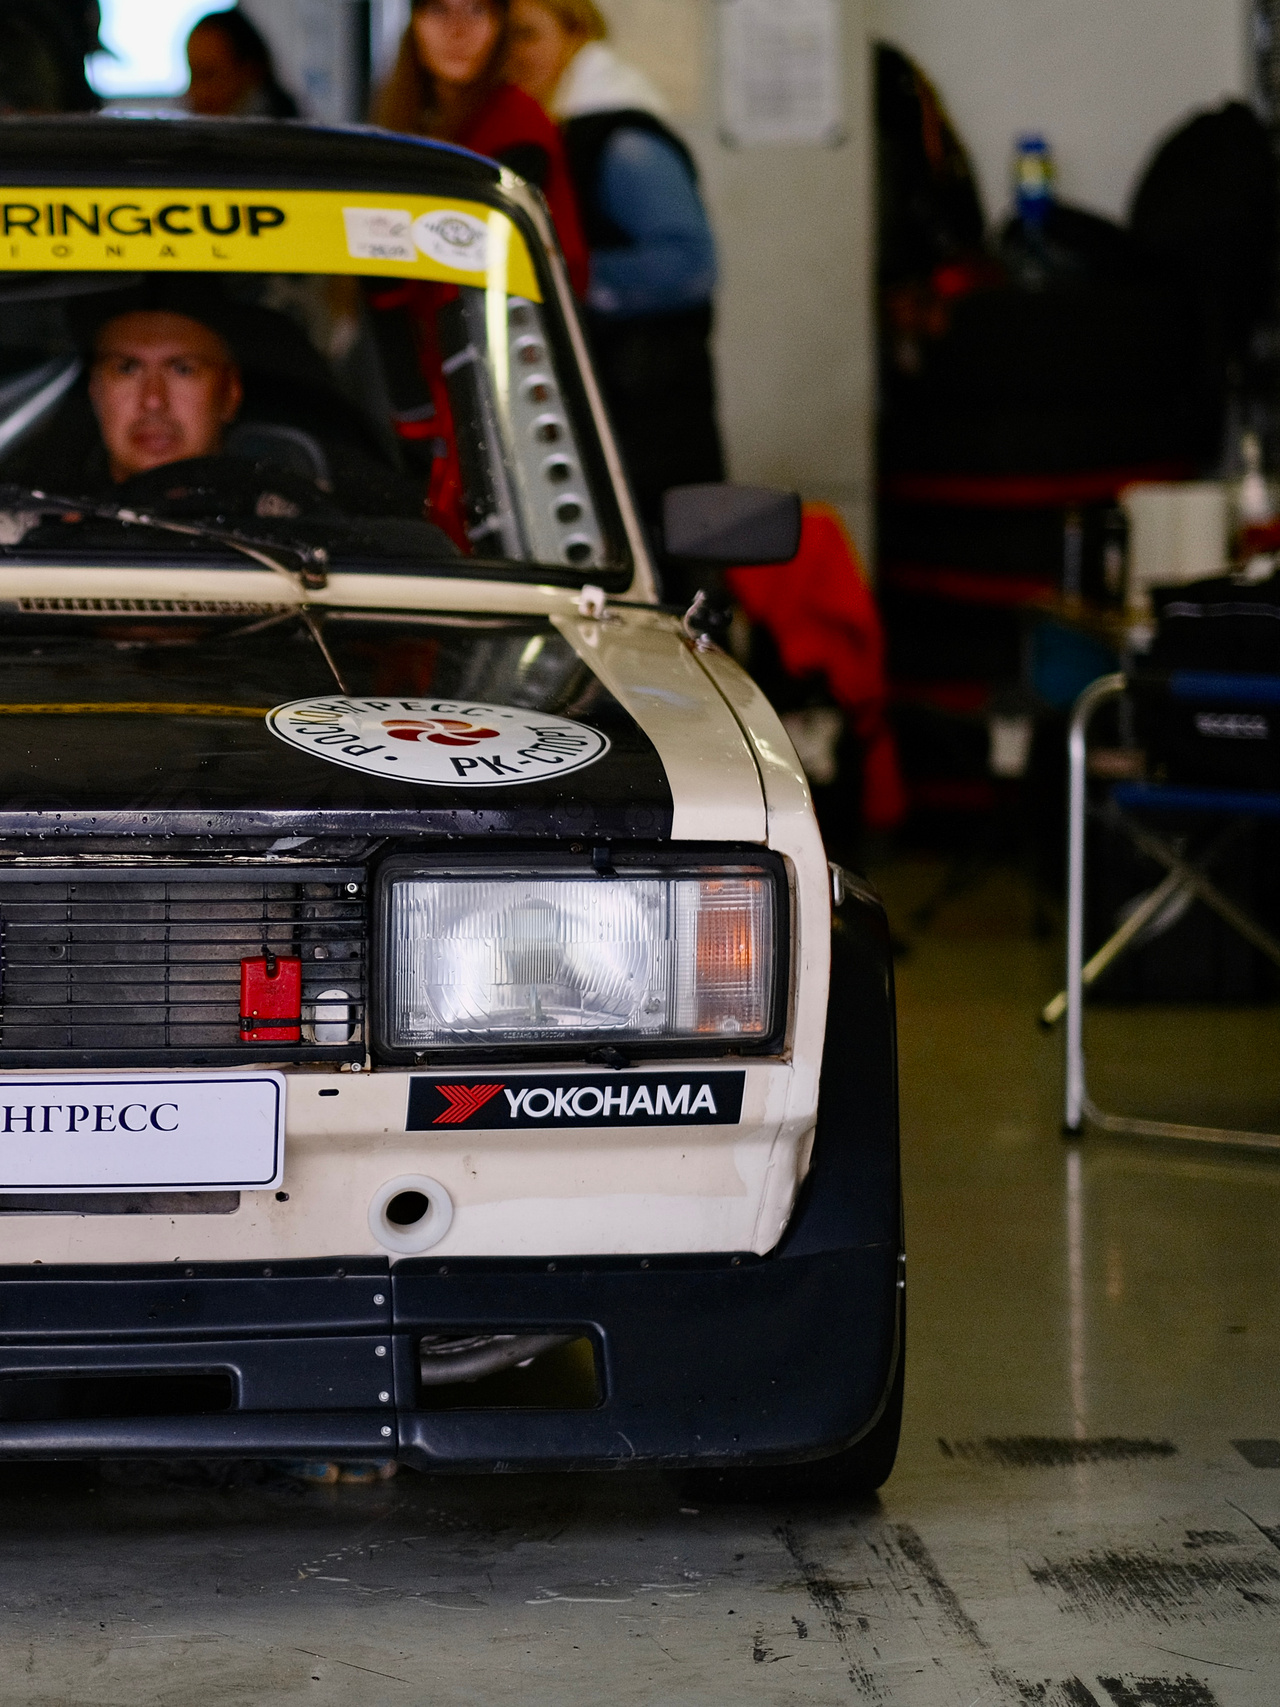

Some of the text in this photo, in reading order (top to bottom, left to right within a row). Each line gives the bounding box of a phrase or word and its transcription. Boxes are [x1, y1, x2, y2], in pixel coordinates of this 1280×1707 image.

[288, 700, 494, 757] РОСКОНГРЕСС
[449, 725, 589, 777] РК-СПОРТ
[504, 1084, 718, 1118] YOKOHAMA
